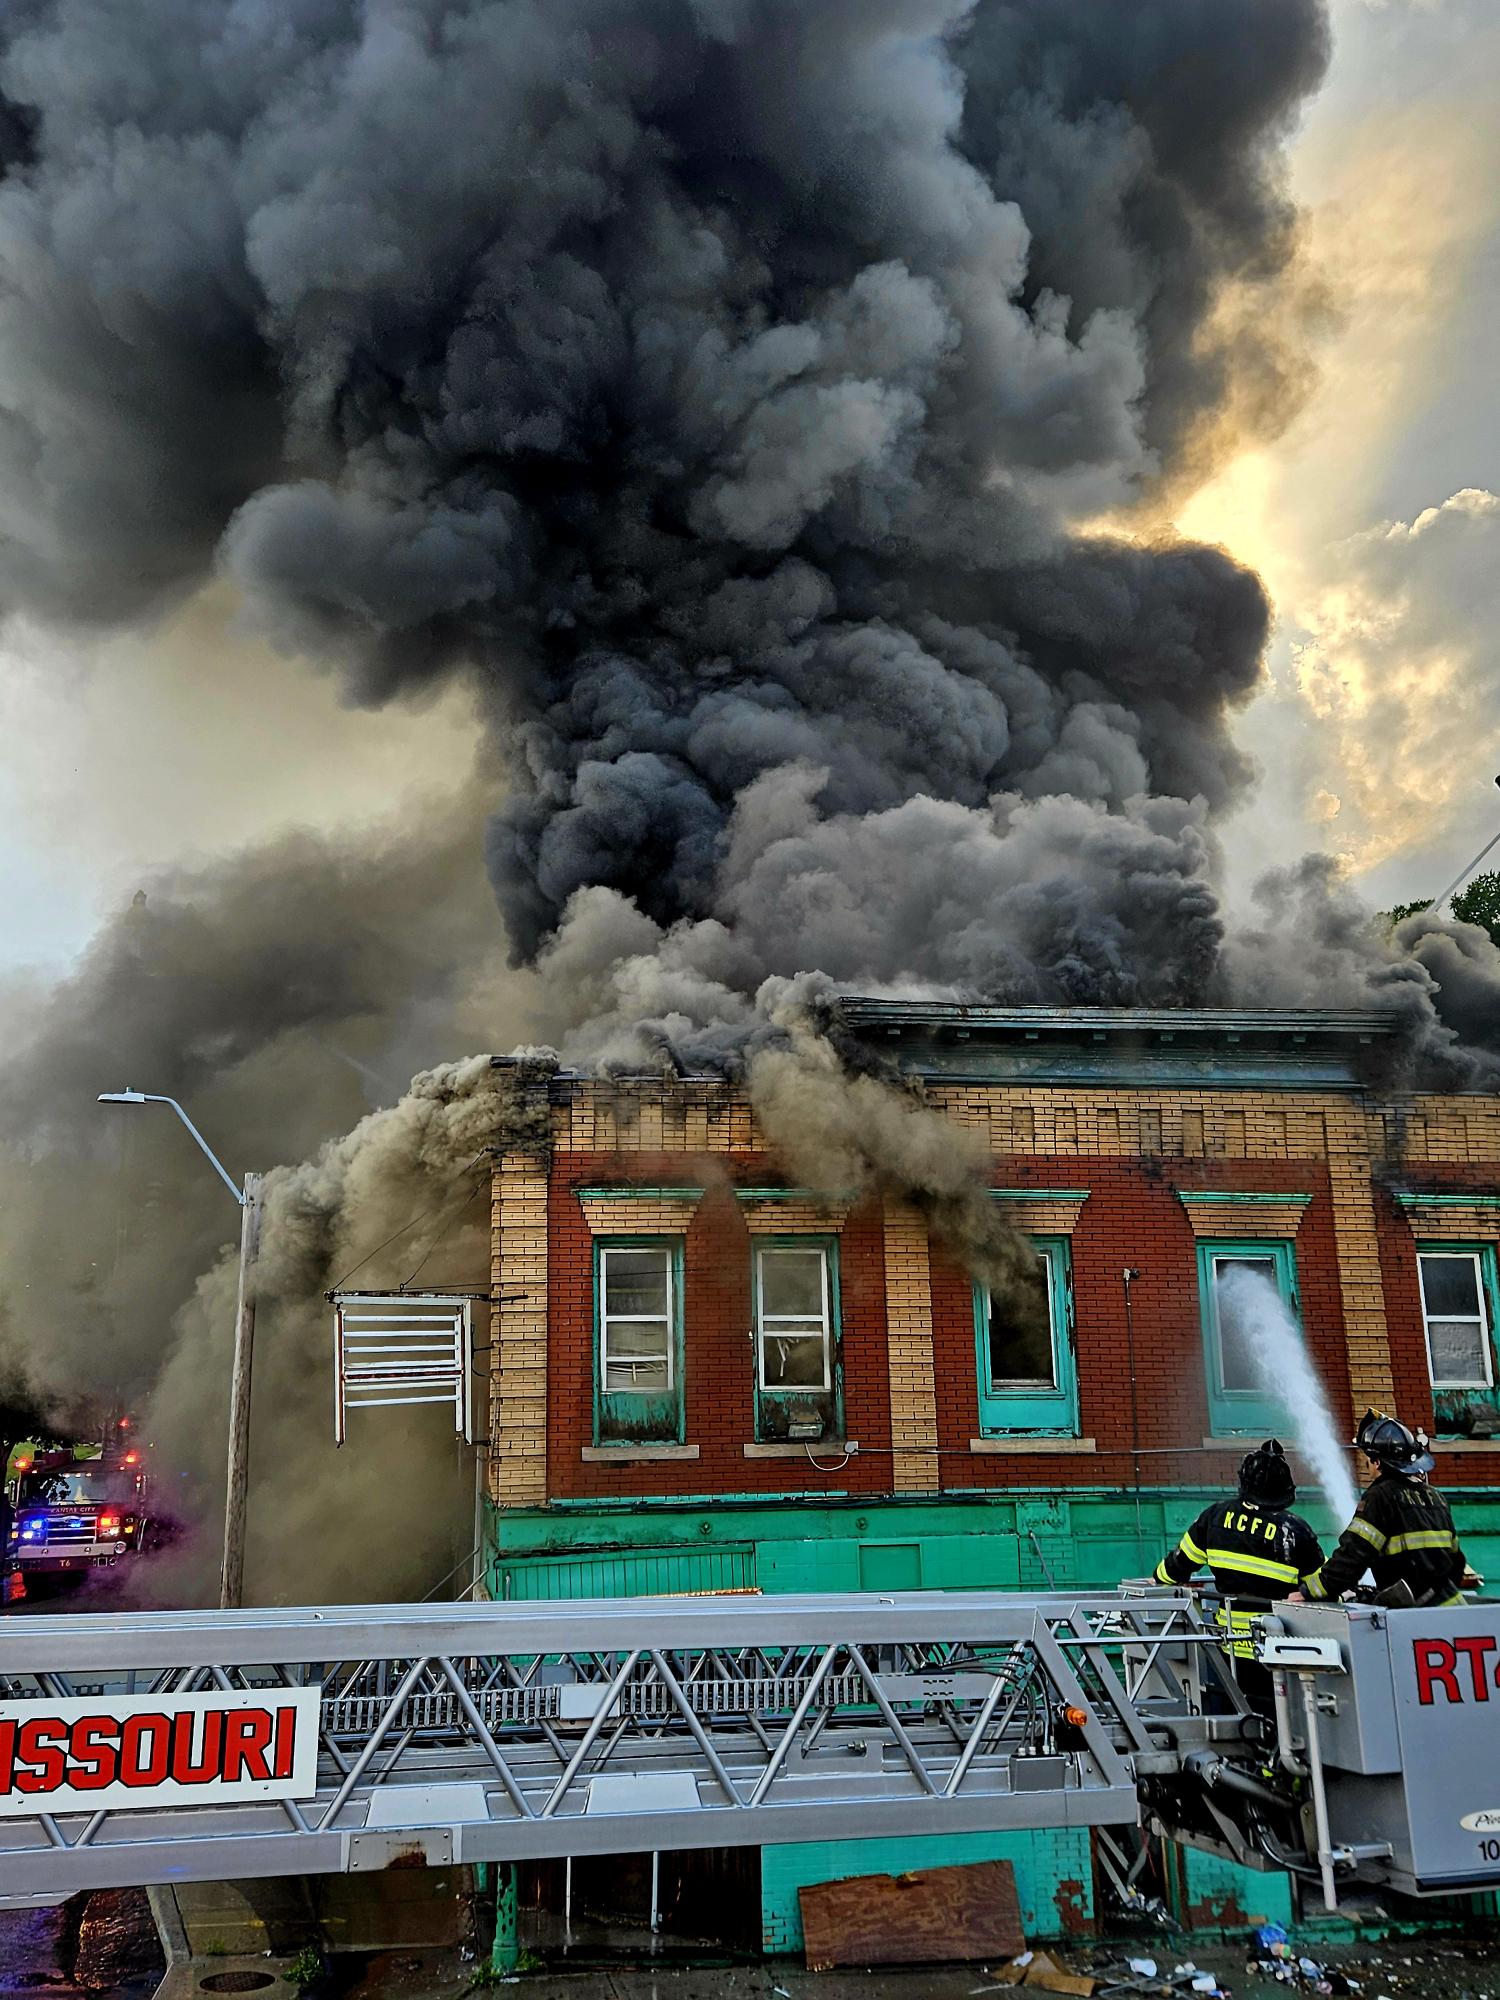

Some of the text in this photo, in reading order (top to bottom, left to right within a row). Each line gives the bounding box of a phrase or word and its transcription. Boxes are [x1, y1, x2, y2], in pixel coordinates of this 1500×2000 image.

[1223, 1511, 1277, 1541] KCFD
[59, 1559, 71, 1567] T6
[1412, 1635, 1500, 1706] RT
[0, 1706, 297, 1796] ISSOURI
[1477, 1839, 1500, 1862] 10
